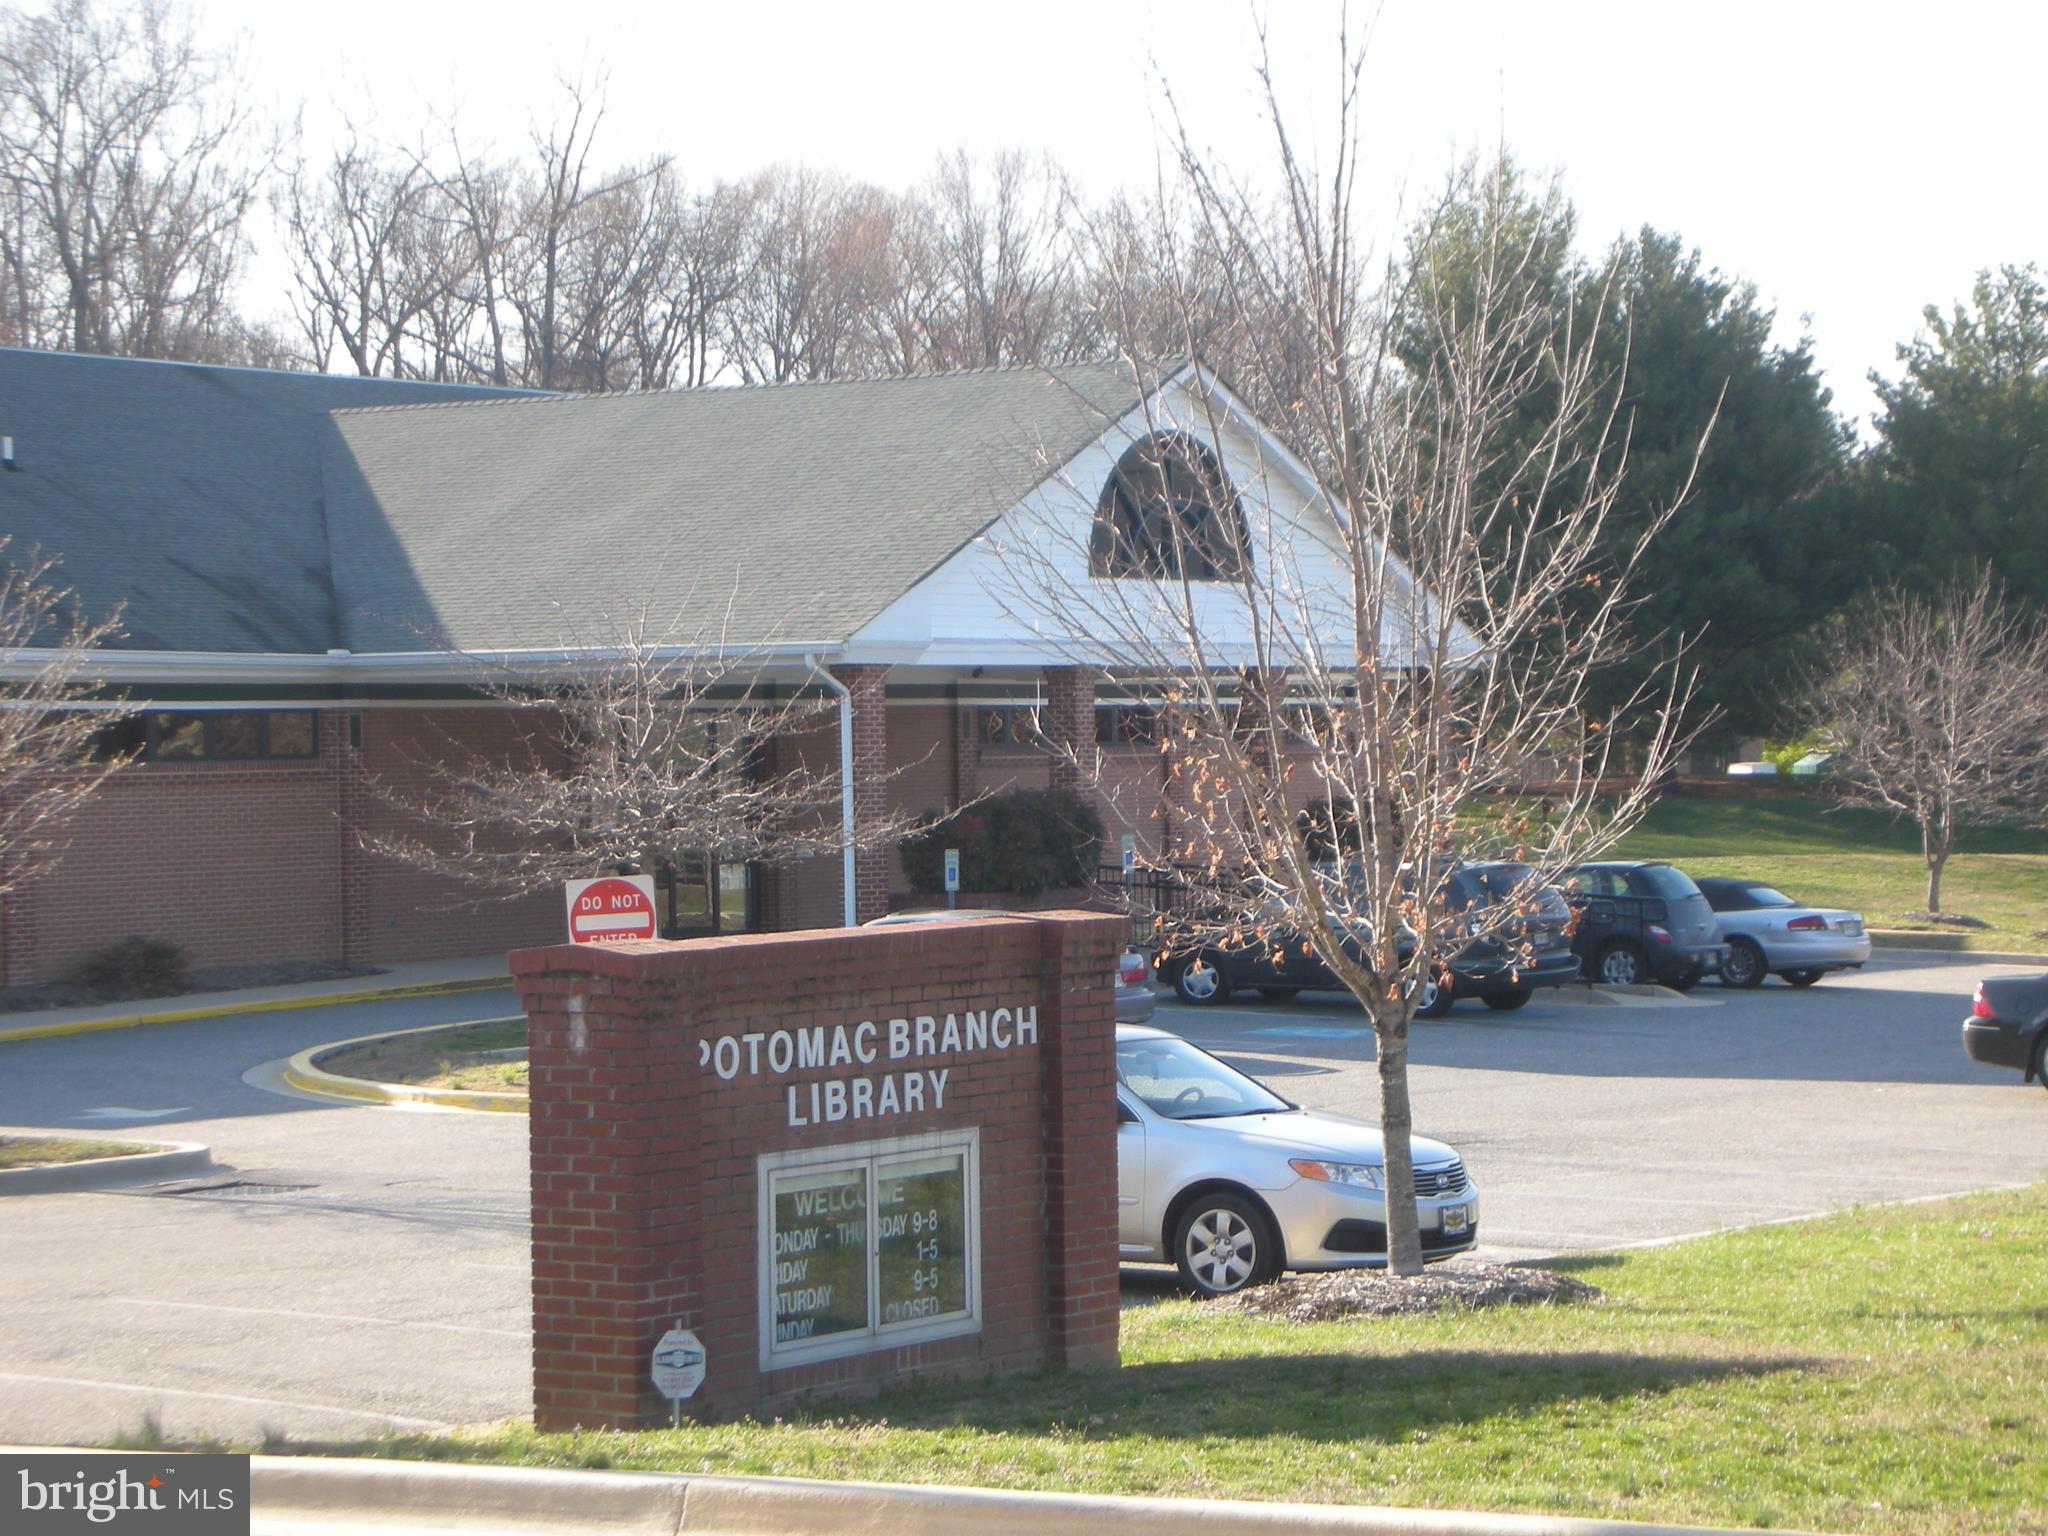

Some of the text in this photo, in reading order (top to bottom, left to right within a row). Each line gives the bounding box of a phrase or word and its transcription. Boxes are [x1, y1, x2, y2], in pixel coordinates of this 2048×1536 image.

[582, 893, 641, 911] DO NOT
[888, 1005, 1038, 1060] BRANCH
[788, 1068, 950, 1127] LIBRARY
[775, 1227, 819, 1255] ONDAY
[912, 1209, 938, 1234] 9-8
[916, 1238, 938, 1261] 1-5
[913, 1267, 938, 1292] 9-5
